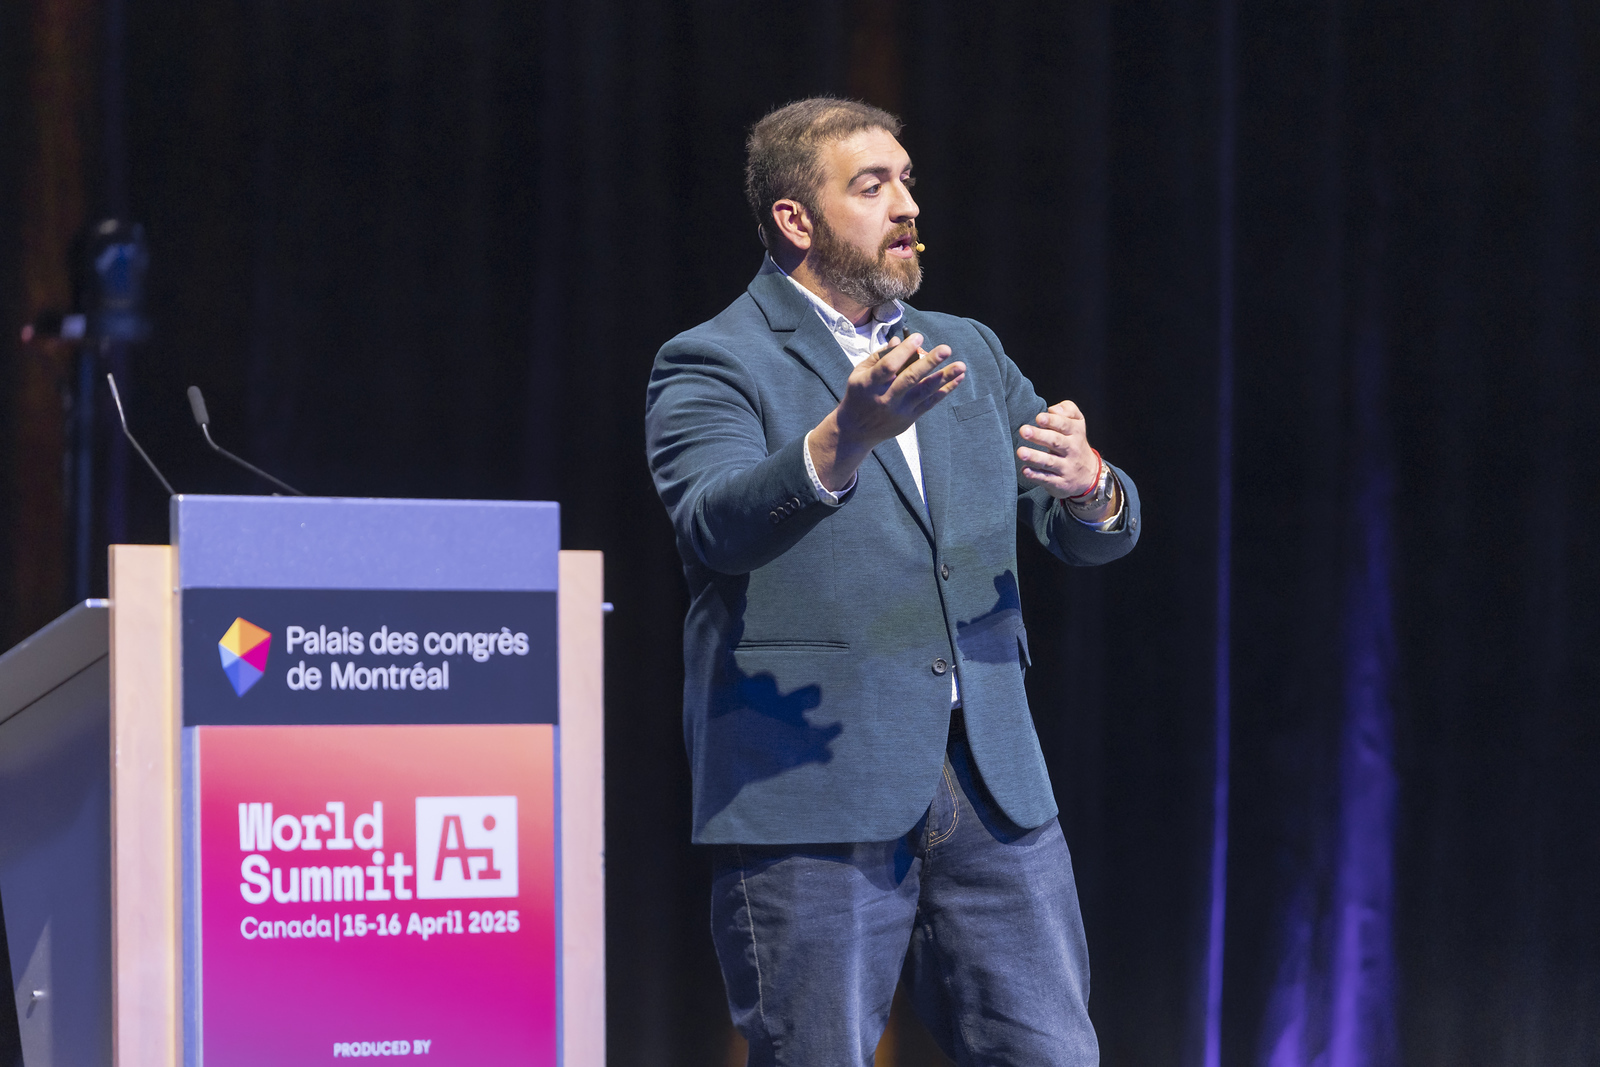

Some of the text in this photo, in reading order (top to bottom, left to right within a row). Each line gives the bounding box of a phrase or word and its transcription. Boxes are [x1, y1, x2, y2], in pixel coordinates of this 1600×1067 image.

[286, 624, 529, 662] Palais des congrès
[286, 661, 449, 691] de Montréal
[238, 801, 383, 851] World
[240, 851, 413, 904] Summit
[406, 910, 464, 940] April
[468, 910, 520, 933] 2025
[333, 1039, 431, 1058] PRODUCED BY
